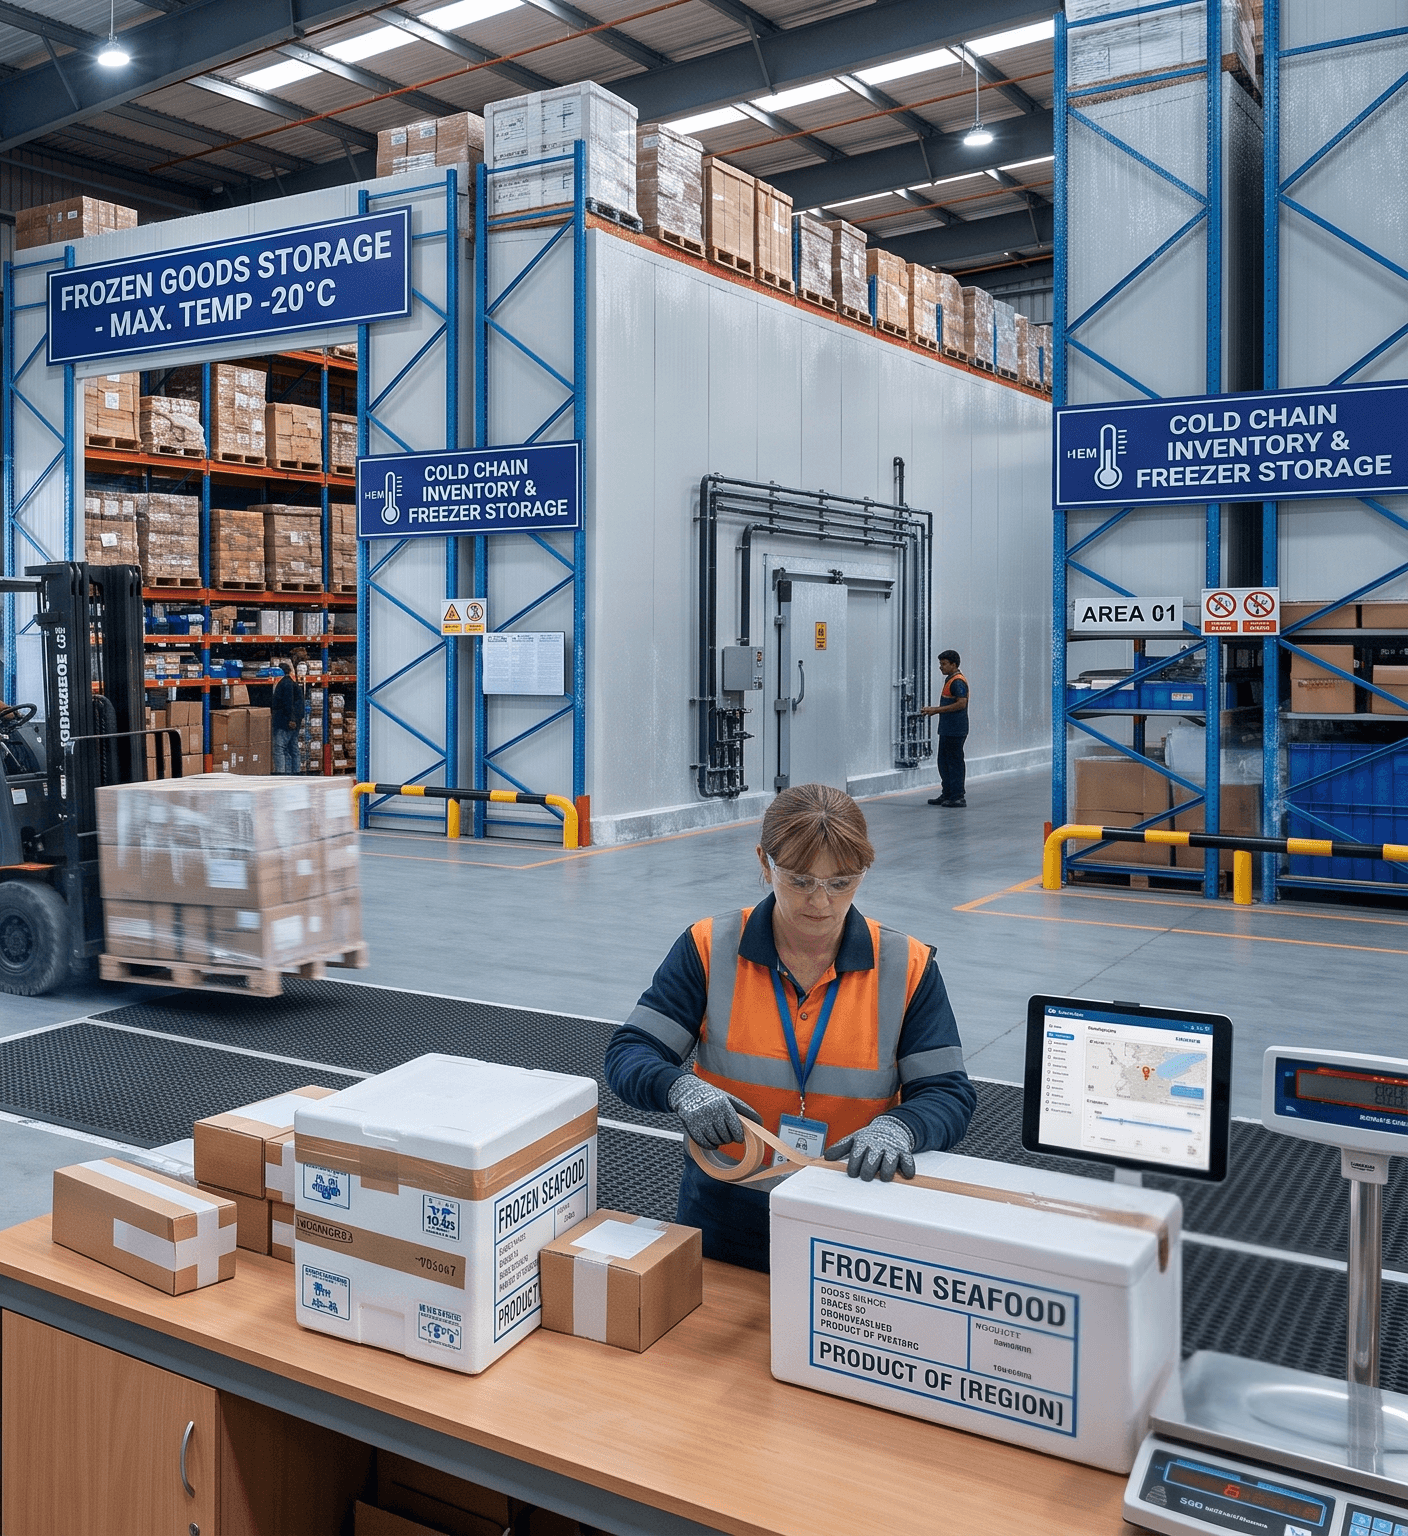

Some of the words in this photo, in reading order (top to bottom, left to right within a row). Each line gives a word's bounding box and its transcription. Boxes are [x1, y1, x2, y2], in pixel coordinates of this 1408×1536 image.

[61, 271, 152, 311] FROZEN
[160, 255, 250, 295] GOODS
[257, 229, 392, 280] STORAGE
[110, 304, 172, 337] MAX.
[179, 292, 252, 328] TEMP
[260, 278, 336, 314] -20°C
[1169, 411, 1241, 435] COLD
[1249, 404, 1337, 430] CHAIN
[1067, 447, 1097, 459] HEM
[1167, 432, 1324, 461] INVENTORY
[1330, 430, 1350, 451] &
[424, 463, 469, 482] COLD
[473, 458, 529, 479] CHAIN
[1136, 463, 1250, 488] FREEZER
[1258, 454, 1392, 482] STORAGE
[364, 491, 384, 500] HEM
[422, 481, 520, 502] INVENTORY
[524, 479, 537, 496] &
[408, 505, 481, 524] FREEZER
[485, 499, 568, 520] STORAGE
[1081, 605, 1145, 623] AREA
[1152, 604, 1175, 622] 01
[498, 1185, 539, 1235] FROZEN
[541, 1157, 586, 1203] SEAFOOD
[820, 1249, 922, 1295] FROZEN
[932, 1274, 1067, 1328] SEAFOOD
[498, 1282, 539, 1331] PRODUCT
[820, 1318, 861, 1336] PRODUCT
[819, 1340, 918, 1384] PRODUCT
[924, 1368, 952, 1392] OF
[960, 1376, 1063, 1427] [REGION]
